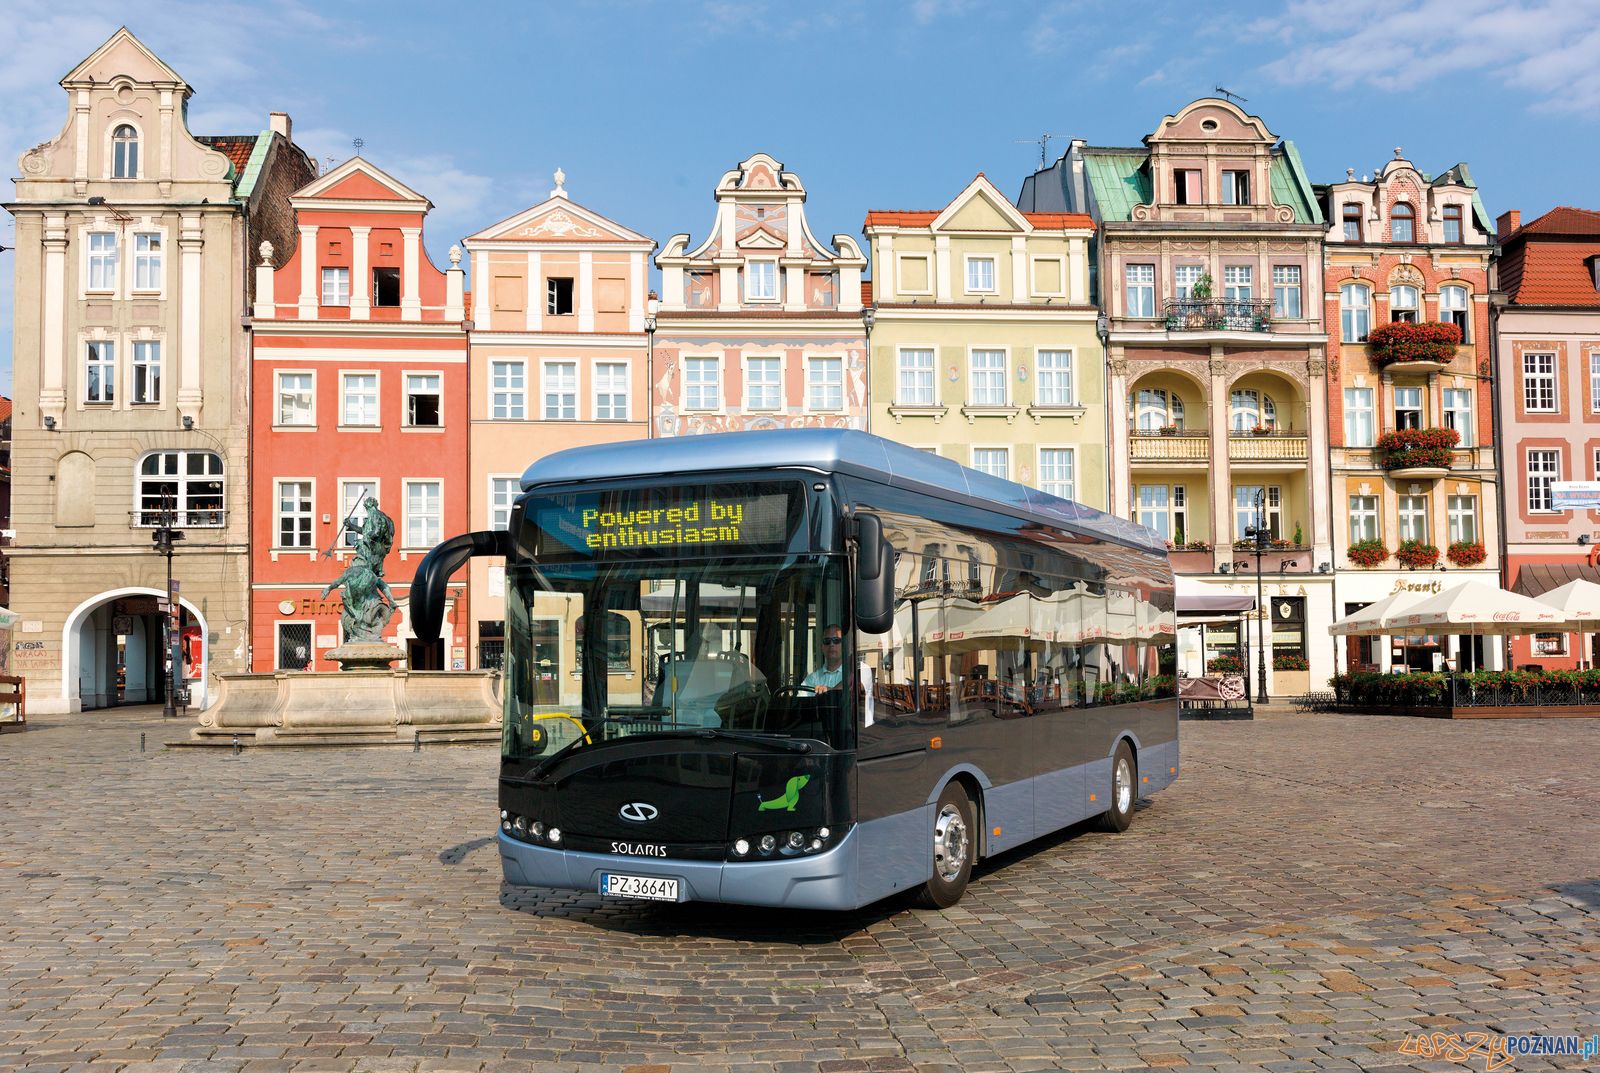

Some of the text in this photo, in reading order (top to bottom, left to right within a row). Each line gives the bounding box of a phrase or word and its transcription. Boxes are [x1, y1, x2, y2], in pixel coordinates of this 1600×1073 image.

[582, 501, 743, 527] Powered by
[585, 525, 739, 547] enthusiasm
[611, 842, 667, 857] SOLARIS
[633, 878, 675, 897] 3664Y
